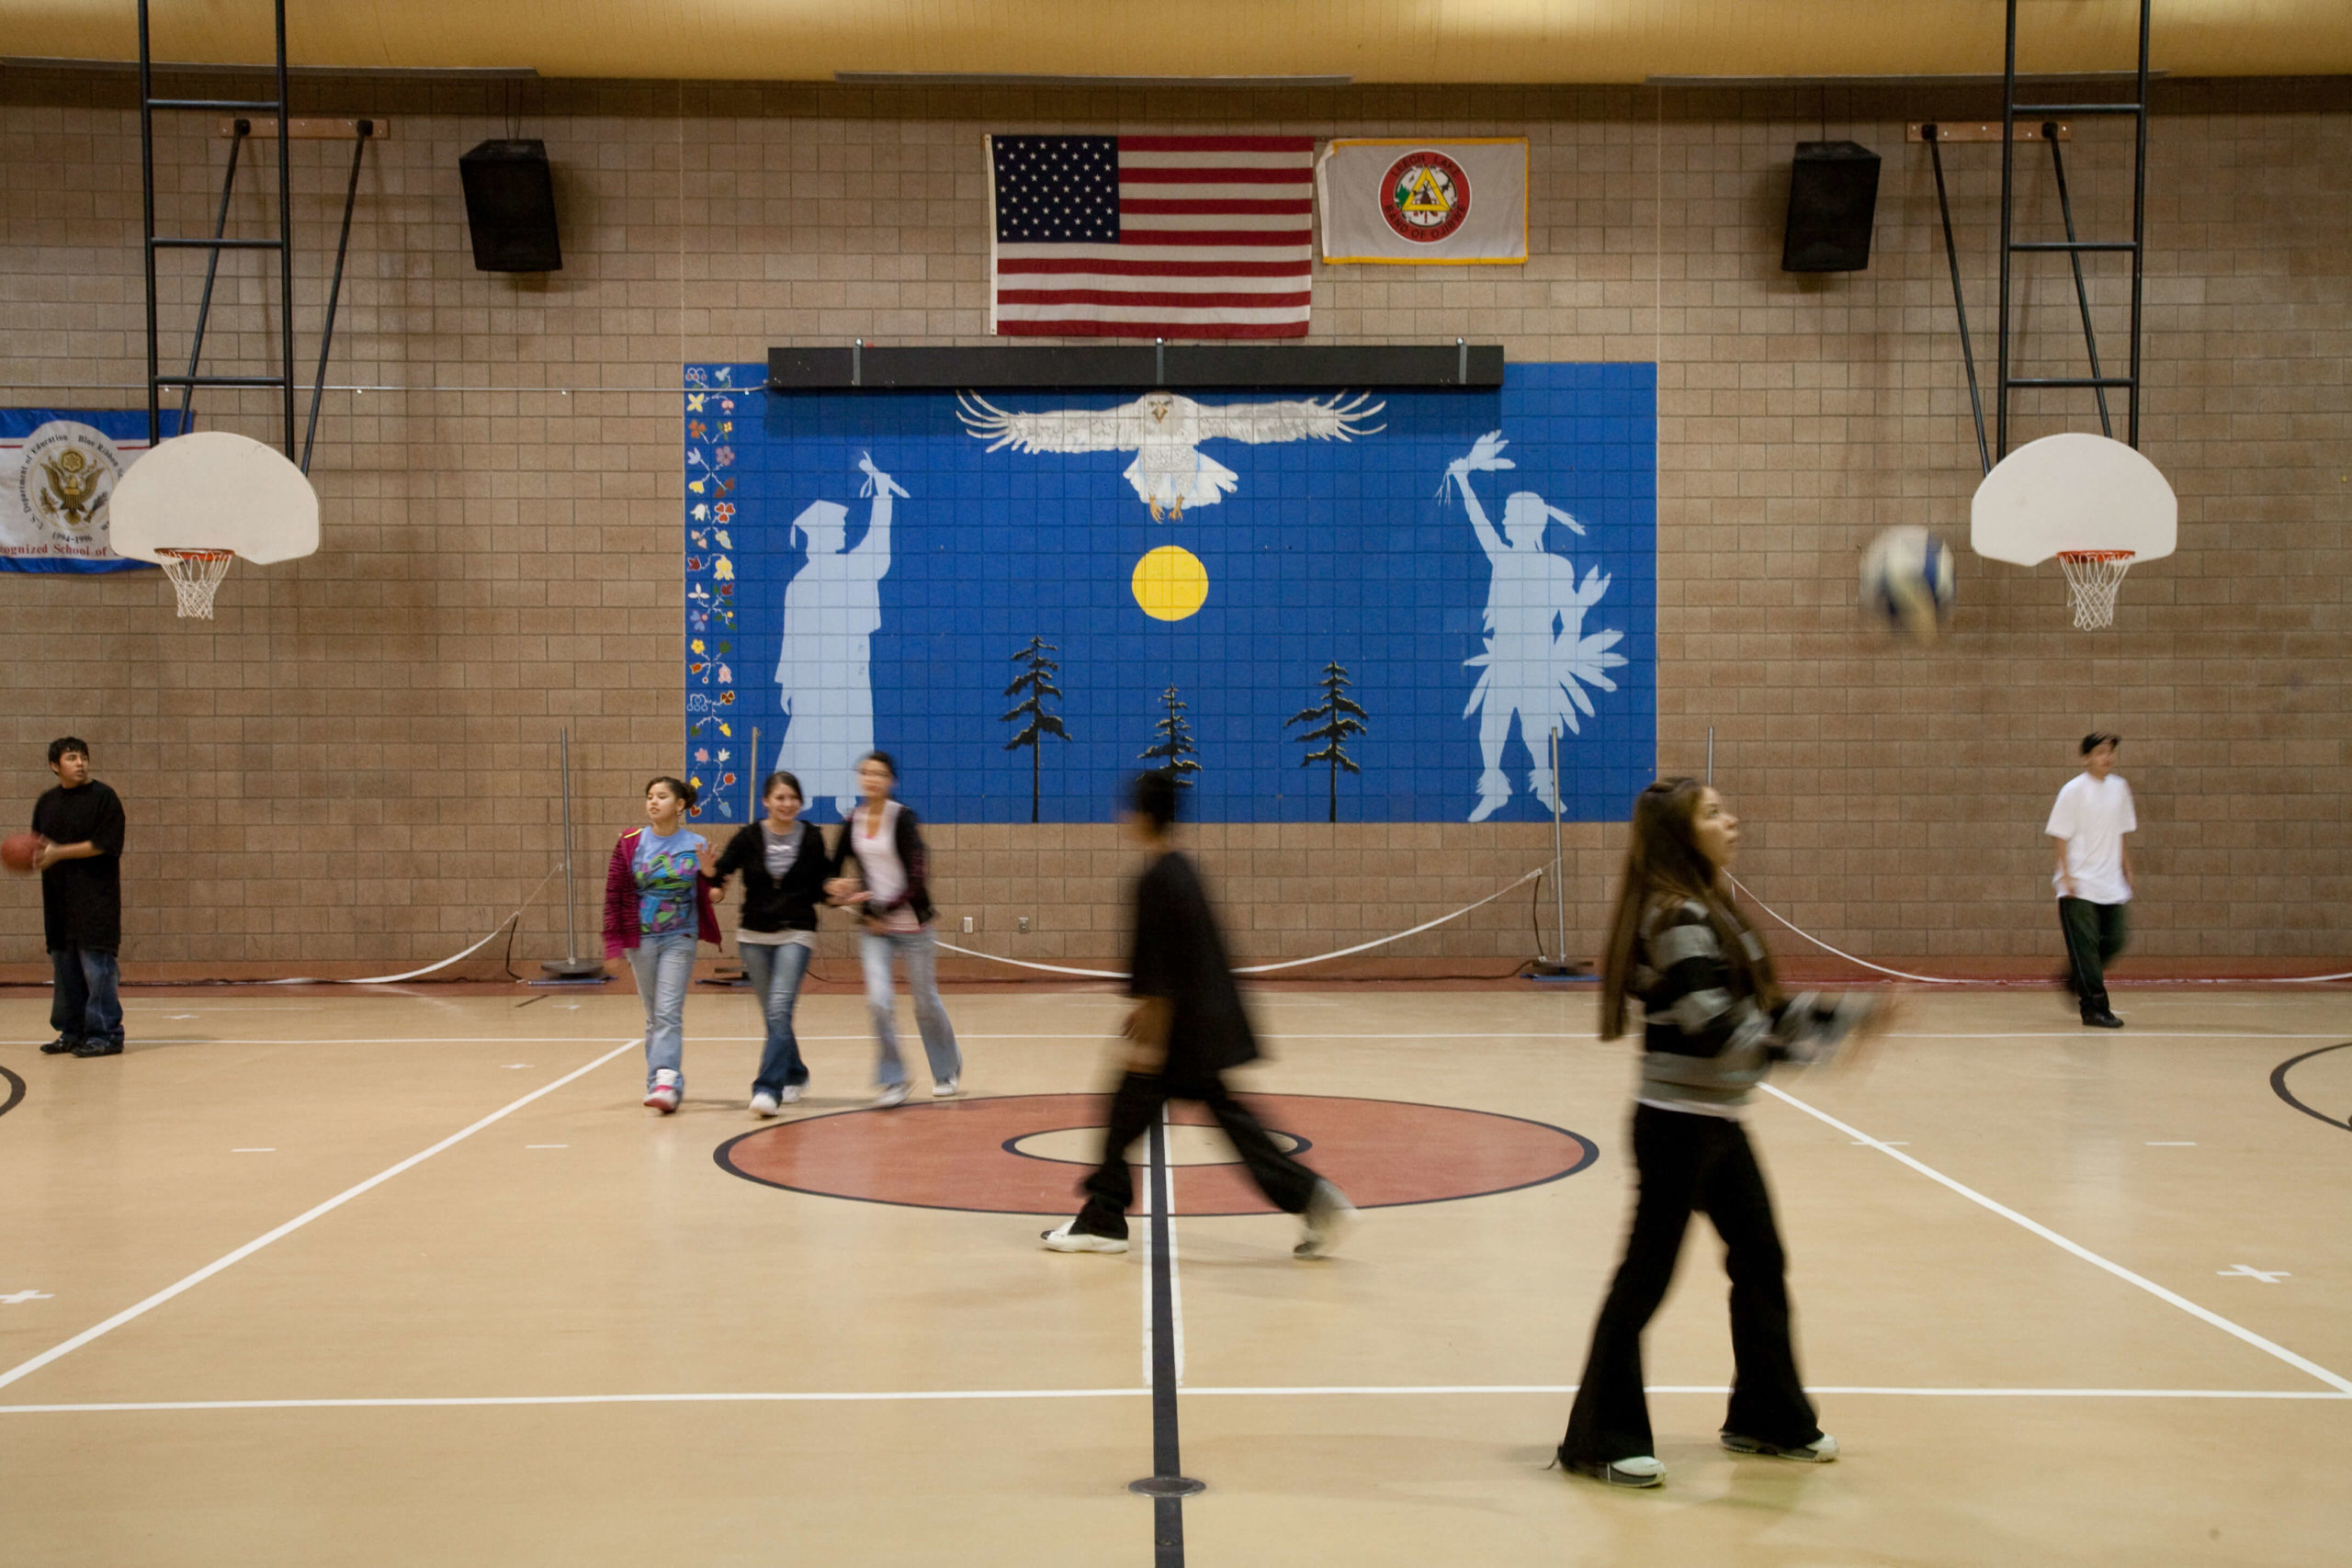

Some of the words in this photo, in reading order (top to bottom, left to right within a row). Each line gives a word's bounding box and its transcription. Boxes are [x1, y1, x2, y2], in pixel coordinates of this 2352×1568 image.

[1391, 154, 1425, 176] LEECH
[1434, 156, 1462, 176] LAKE
[1385, 205, 1408, 231] BAND
[1411, 230, 1426, 240] OF
[1431, 206, 1466, 238] OJIBWE
[19, 466, 31, 513] Department
[26, 455, 33, 464] of
[31, 434, 68, 455] Education
[78, 434, 96, 446] Blue
[96, 444, 119, 467] Ribbon
[53, 542, 89, 557] School
[96, 546, 108, 556] of
